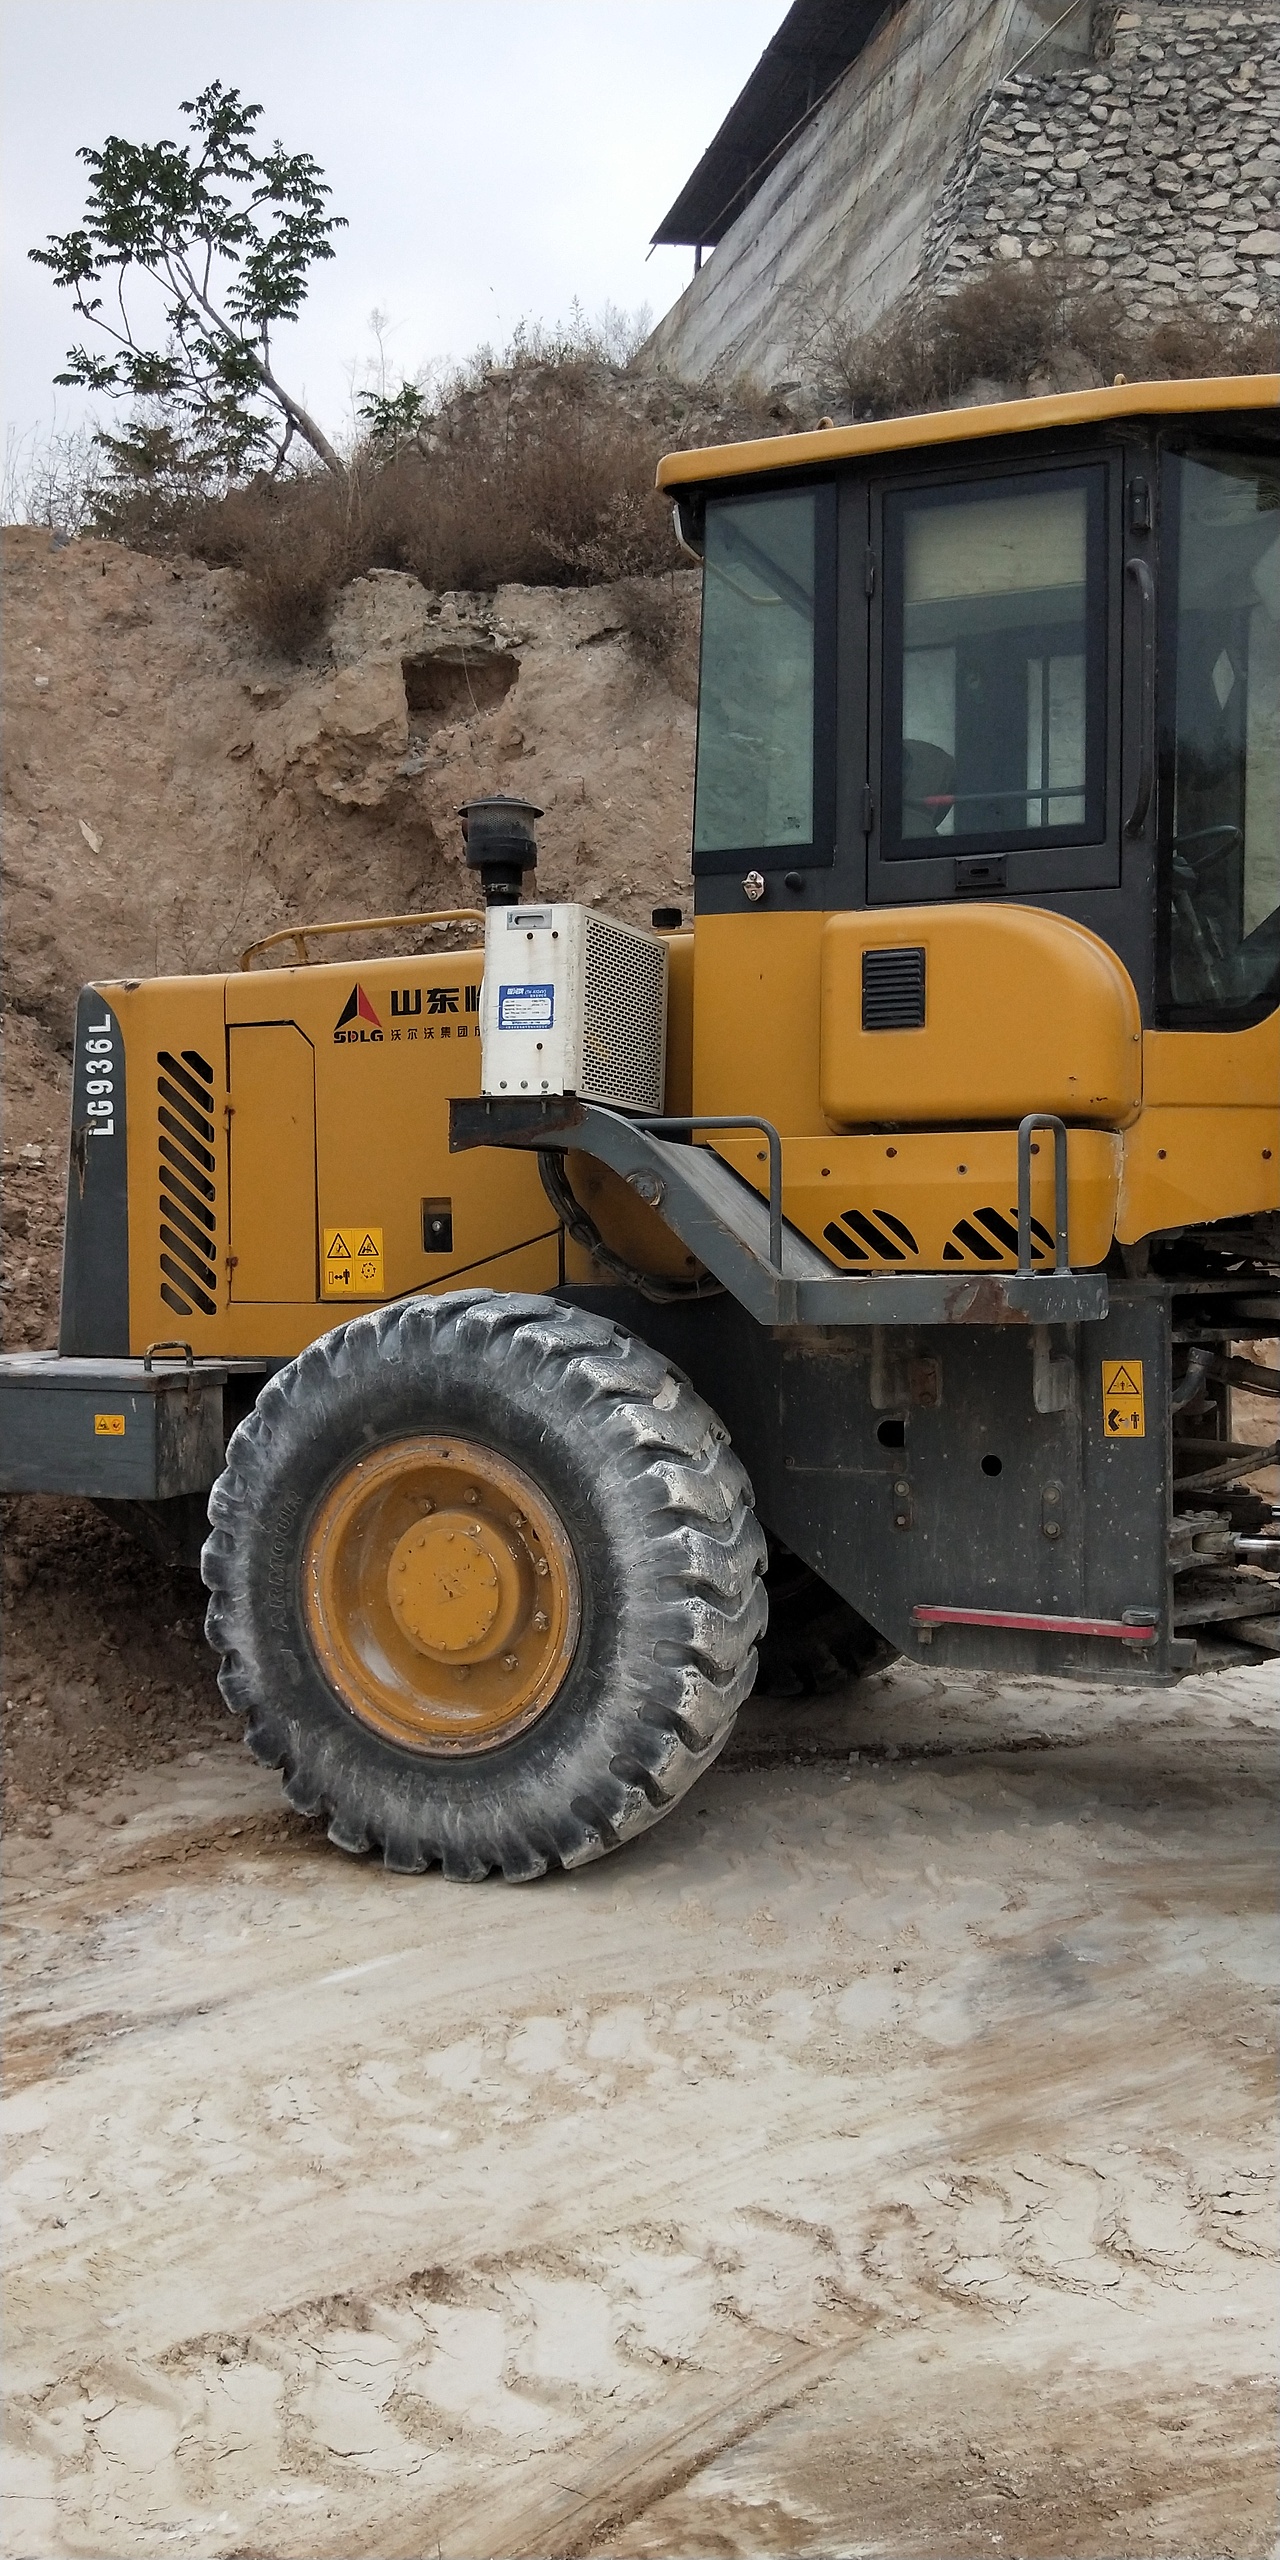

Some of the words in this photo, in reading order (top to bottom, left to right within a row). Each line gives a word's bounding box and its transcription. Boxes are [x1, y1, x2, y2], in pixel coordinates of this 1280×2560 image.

[85, 1013, 115, 1136] LG936L
[333, 1029, 384, 1044] SDLG
[268, 1490, 303, 1632] ARMOUR
